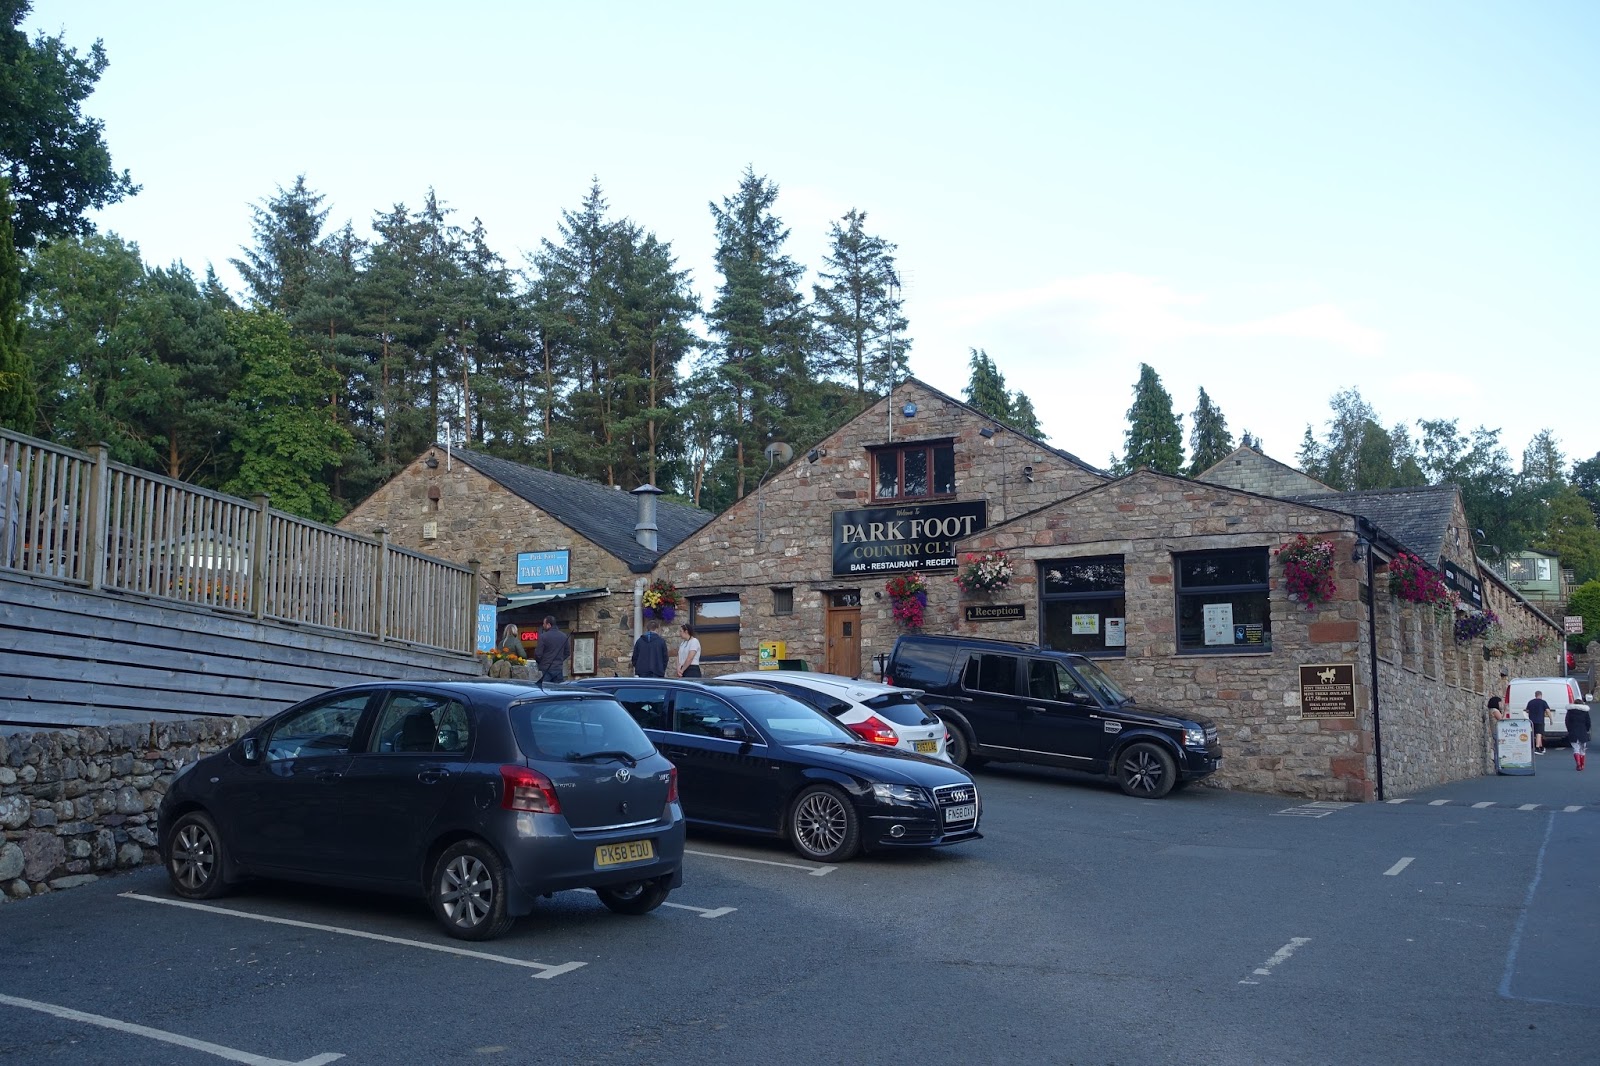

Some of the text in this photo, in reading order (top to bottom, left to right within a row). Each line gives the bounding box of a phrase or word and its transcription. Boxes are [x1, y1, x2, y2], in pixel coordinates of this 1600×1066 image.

[841, 515, 977, 544] PARK FOOT
[853, 542, 922, 559] COUNTRY
[520, 564, 565, 577] TAKE AWAY
[850, 563, 866, 571] BAR
[871, 560, 919, 570] RESTAURANT
[975, 606, 1020, 617] Reception
[521, 631, 539, 642] OPEN
[600, 842, 650, 862] PK58 EDU
